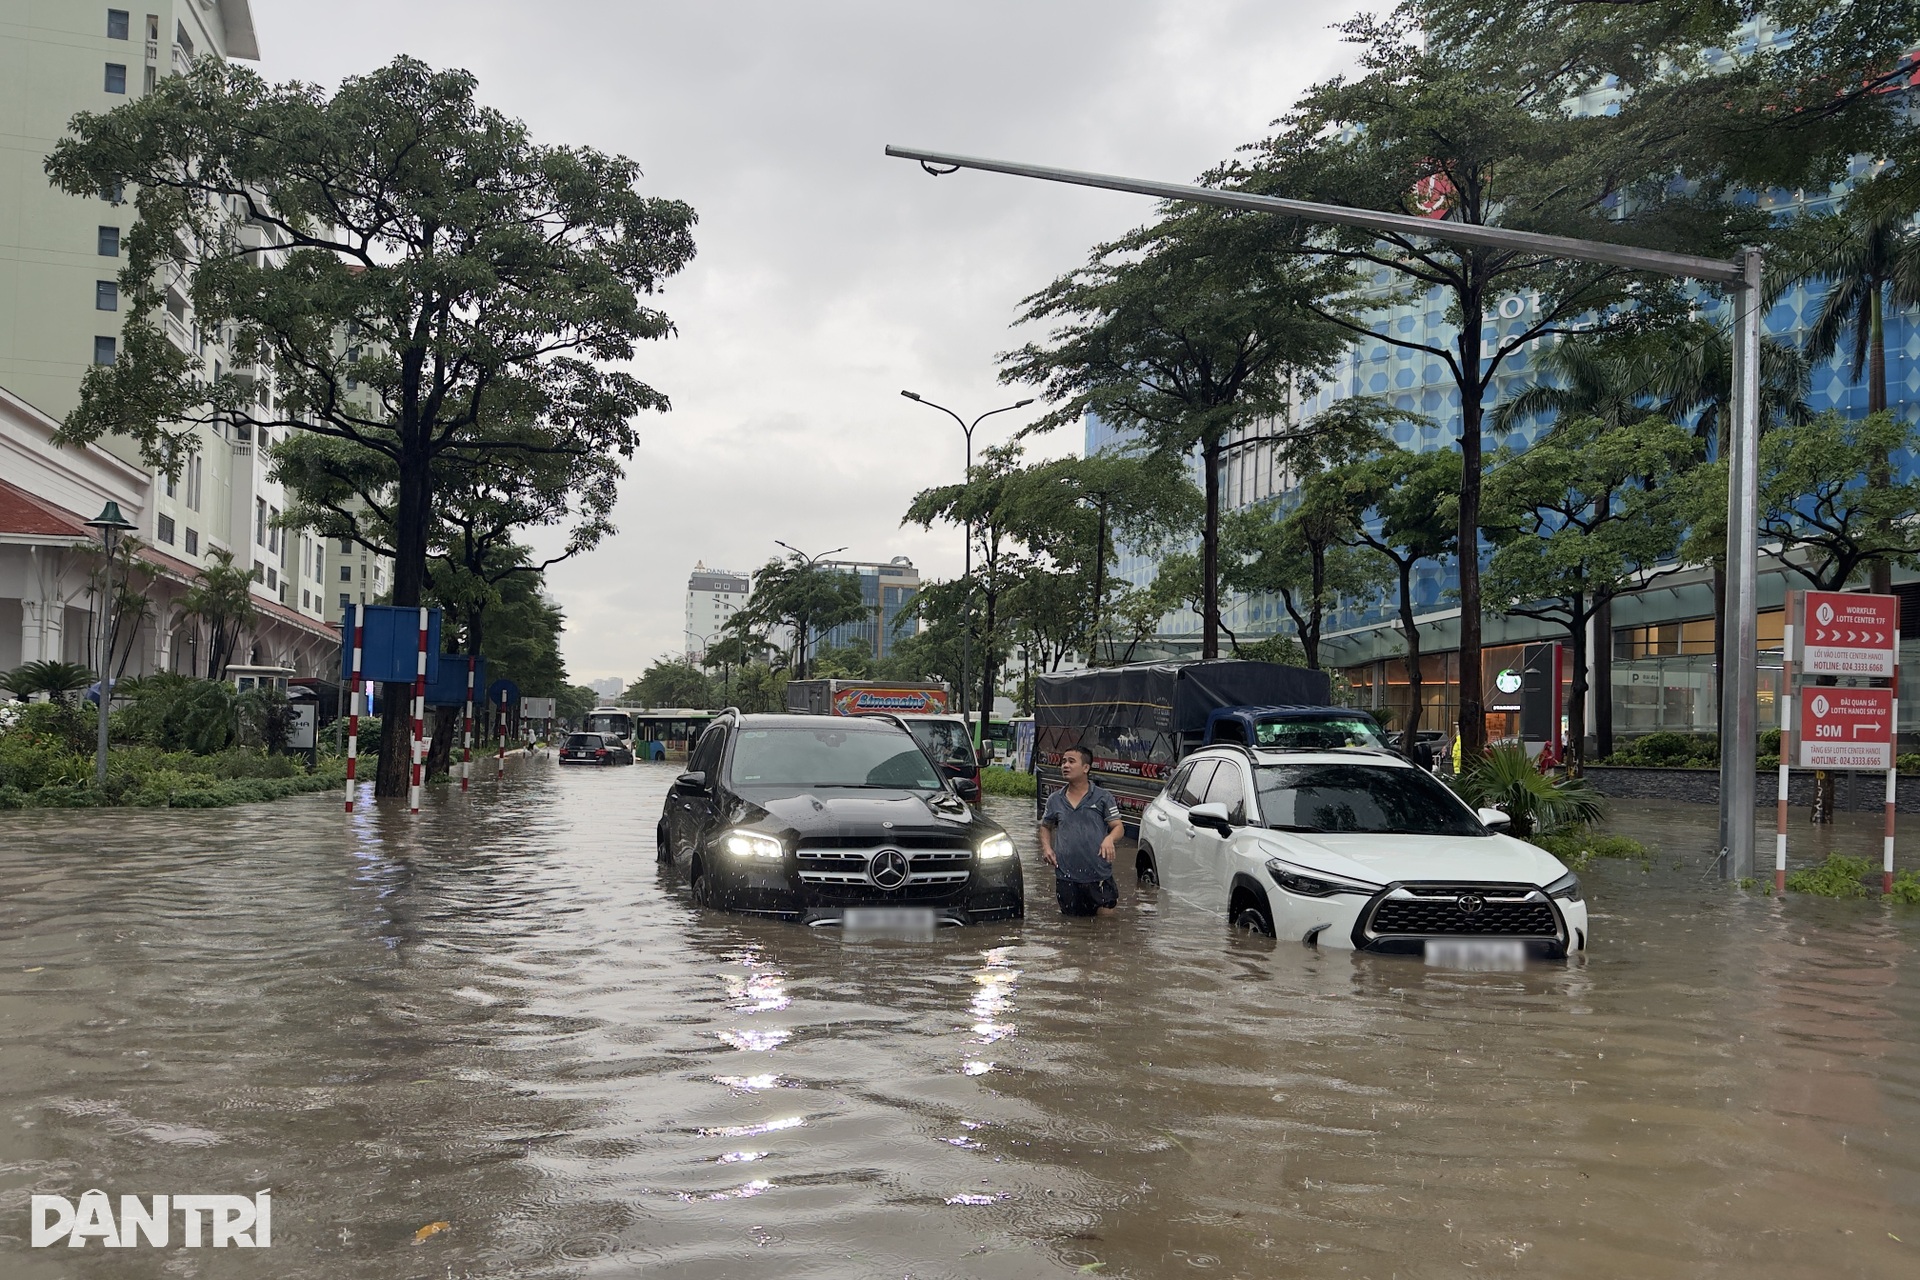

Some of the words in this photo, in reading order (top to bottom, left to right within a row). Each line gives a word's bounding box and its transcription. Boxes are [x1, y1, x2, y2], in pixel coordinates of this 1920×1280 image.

[1846, 606, 1876, 614] WORKFLEX
[1854, 616, 1875, 624] CENTER
[1834, 651, 1848, 659] LOTTE
[1849, 652, 1867, 660] CENTER
[1814, 661, 1841, 670] HOTLINE:
[856, 694, 925, 709] Limousine
[1851, 699, 1867, 707] QUAN
[1867, 698, 1877, 707] SÁT
[1815, 724, 1842, 737] 50M
[1833, 746, 1846, 754] LOTTE
[1865, 747, 1880, 755] HANOI
[1811, 756, 1838, 764] HOTLINE:
